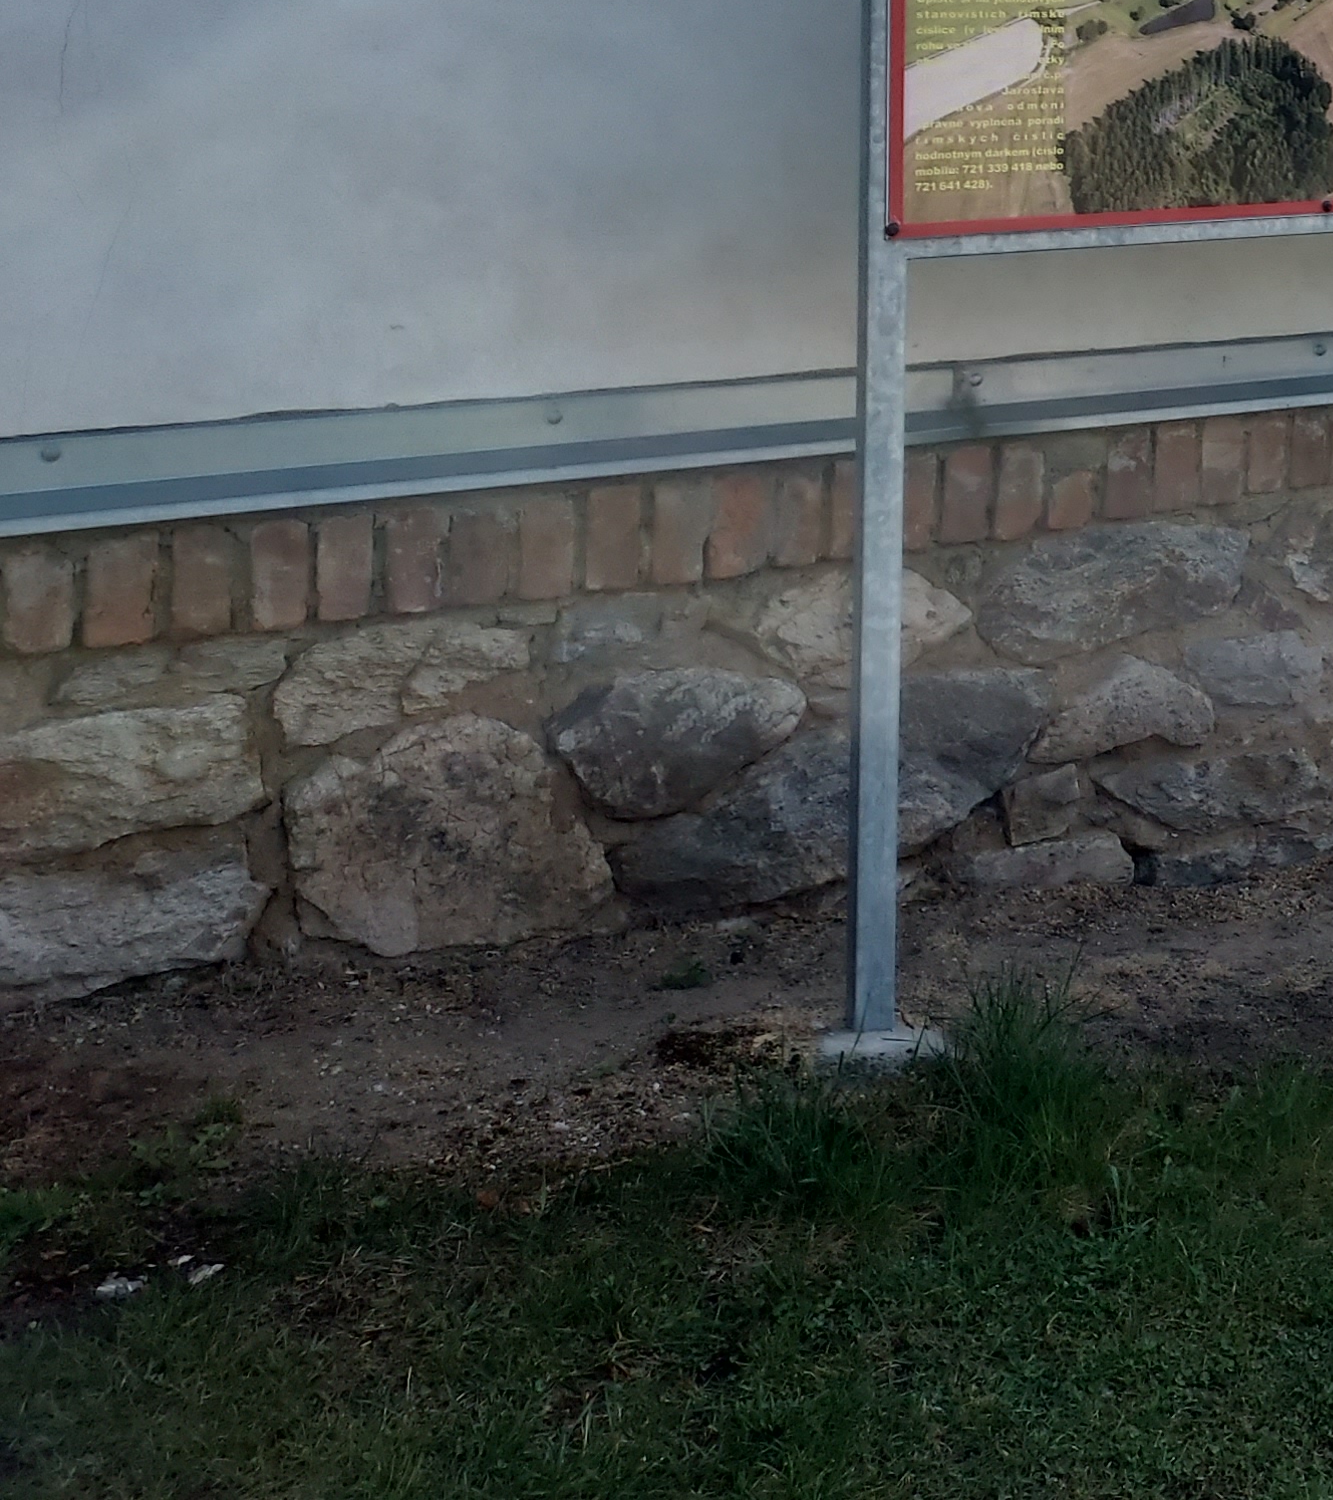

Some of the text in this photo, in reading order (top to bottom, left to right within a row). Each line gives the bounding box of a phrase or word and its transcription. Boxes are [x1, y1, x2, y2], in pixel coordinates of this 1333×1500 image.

[962, 165, 983, 174] 721
[987, 164, 1008, 173] 339
[1011, 162, 1032, 171] 418
[916, 182, 936, 192] 721
[939, 181, 960, 190] 641
